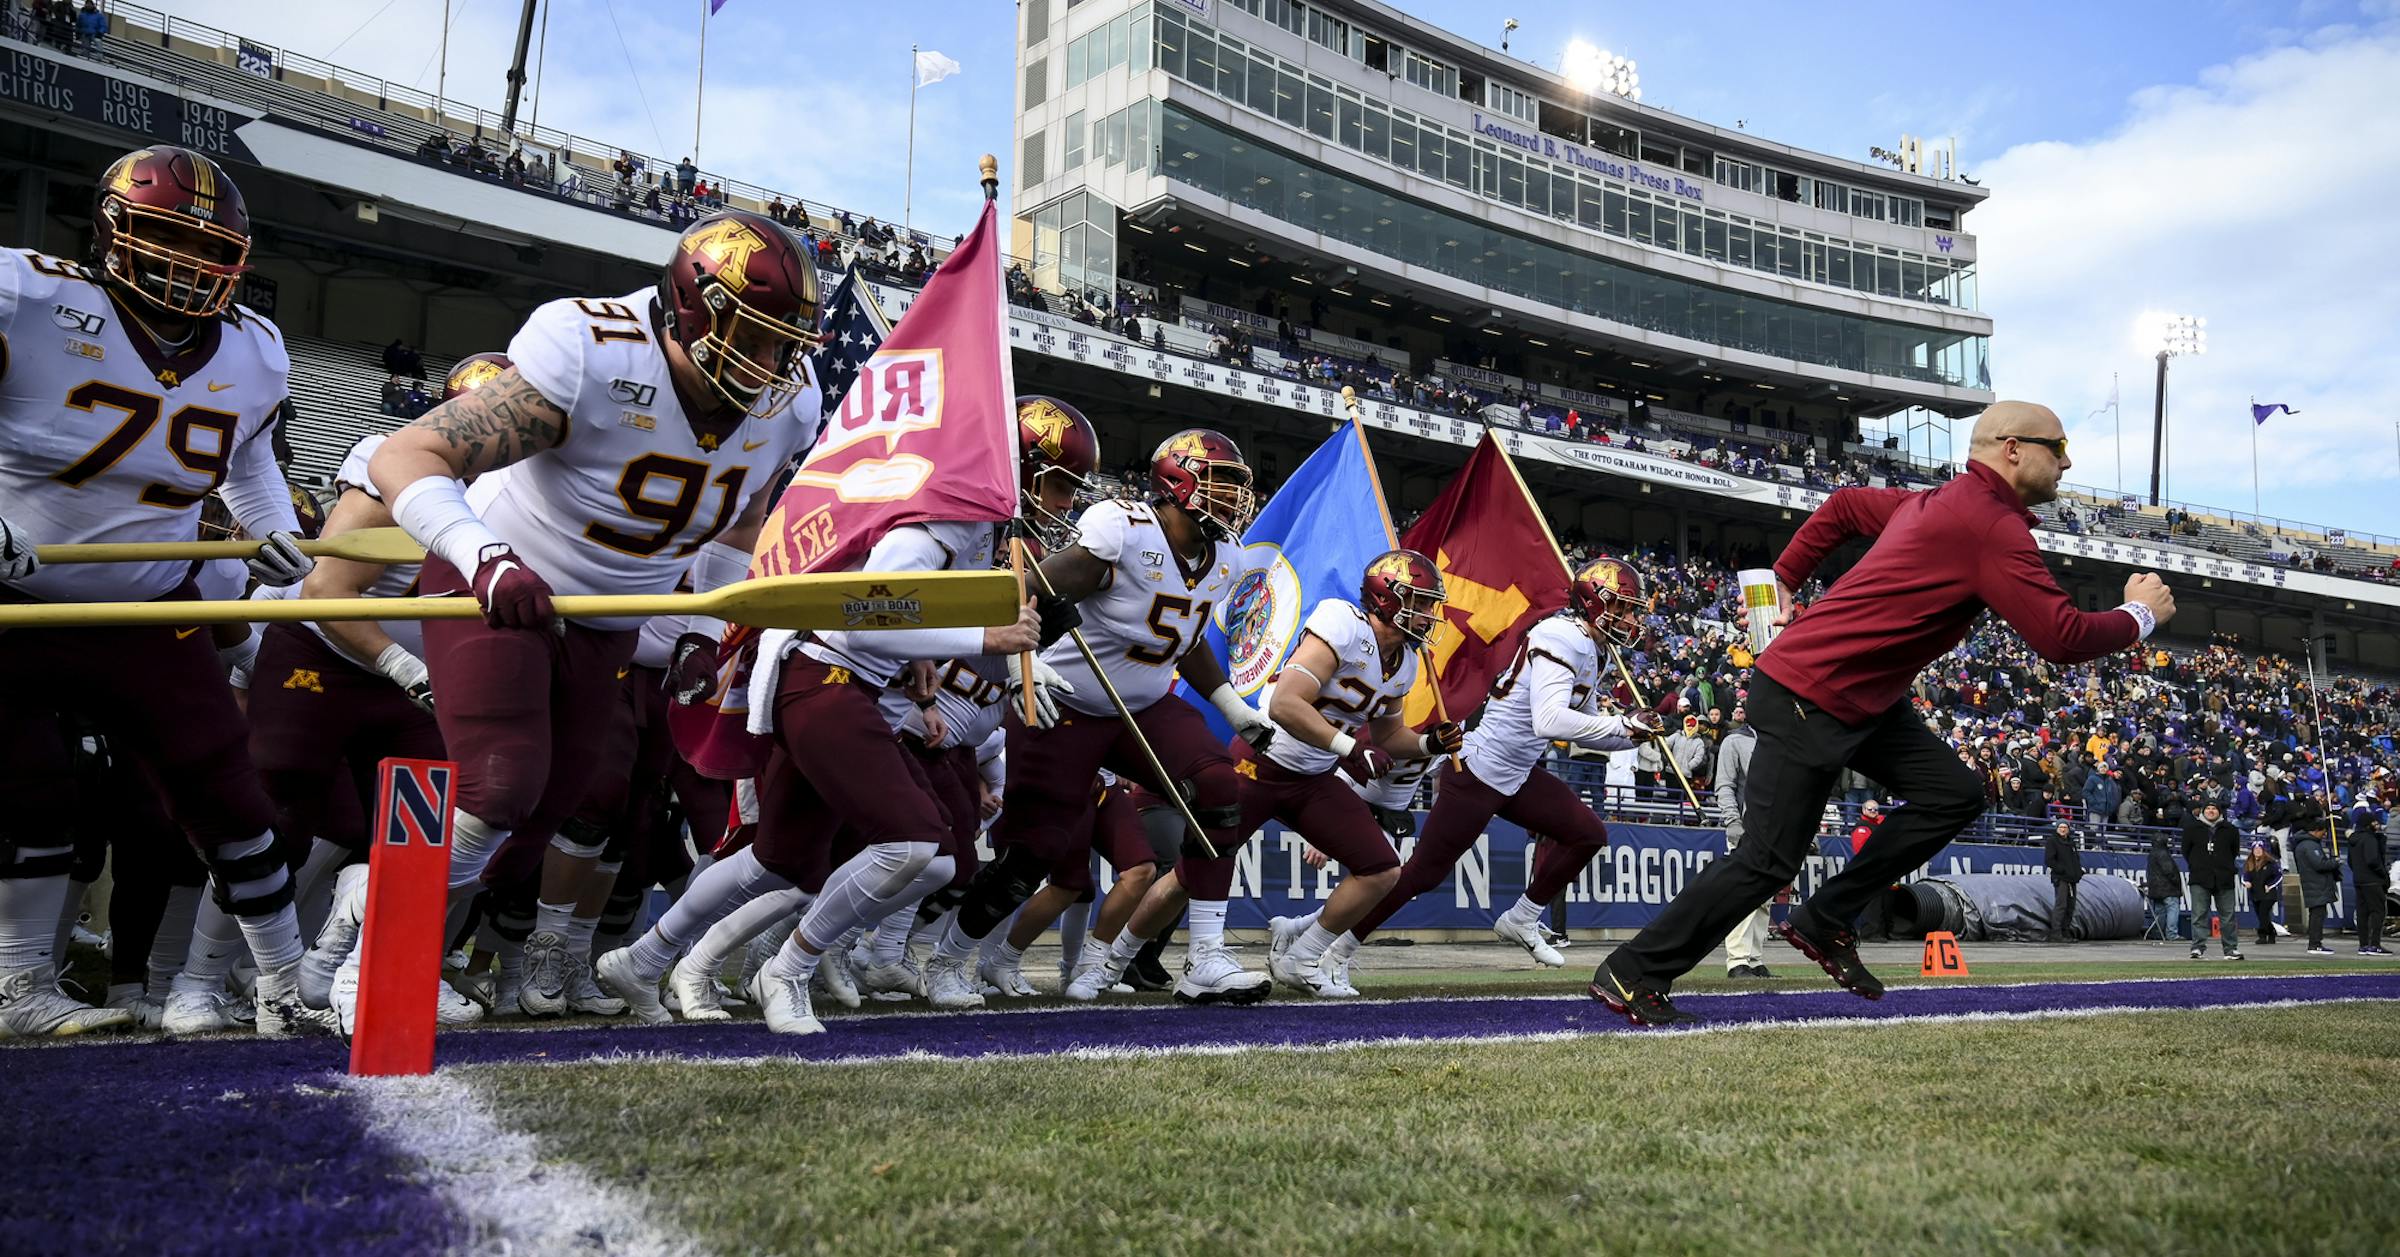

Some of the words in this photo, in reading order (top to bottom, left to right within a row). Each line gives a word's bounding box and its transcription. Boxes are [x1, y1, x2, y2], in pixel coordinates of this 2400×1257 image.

[11, 51, 60, 84] 1997
[239, 52, 270, 79] 225
[0, 72, 74, 111] CITRUS
[104, 78, 150, 110] 1996
[102, 102, 153, 133] ROSE
[183, 100, 227, 132] 1949
[181, 122, 229, 154] ROSE
[1474, 114, 1540, 154] Leonard
[1544, 138, 1560, 159] B.
[1564, 144, 1624, 179] Thomas
[1627, 164, 1670, 191] Press
[1674, 177, 1703, 201] Box
[190, 205, 214, 219] ROW
[52, 304, 107, 336] 150
[1207, 303, 1249, 324] WILDCAT
[1451, 363, 1487, 382] WILDCAT
[608, 378, 660, 408] 150
[1257, 384, 1281, 396] GRAHAM
[49, 379, 240, 509] 79
[1573, 450, 1590, 460] THE
[1591, 453, 1612, 465] OTTO
[1613, 457, 1647, 472] GRAHAM
[1649, 463, 1683, 479] WILDCAT
[1685, 471, 1711, 484] HONOR
[1713, 477, 1732, 488] ROLL
[583, 452, 749, 559] 91
[2123, 500, 2137, 512] 232
[2330, 535, 2345, 545] 233
[1139, 550, 1165, 567] 150
[845, 602, 870, 614] ROW
[888, 601, 919, 611] BOAT
[1126, 592, 1213, 666] 51
[386, 765, 450, 847] N
[1455, 834, 1490, 909] N
[1939, 940, 1958, 969] G
